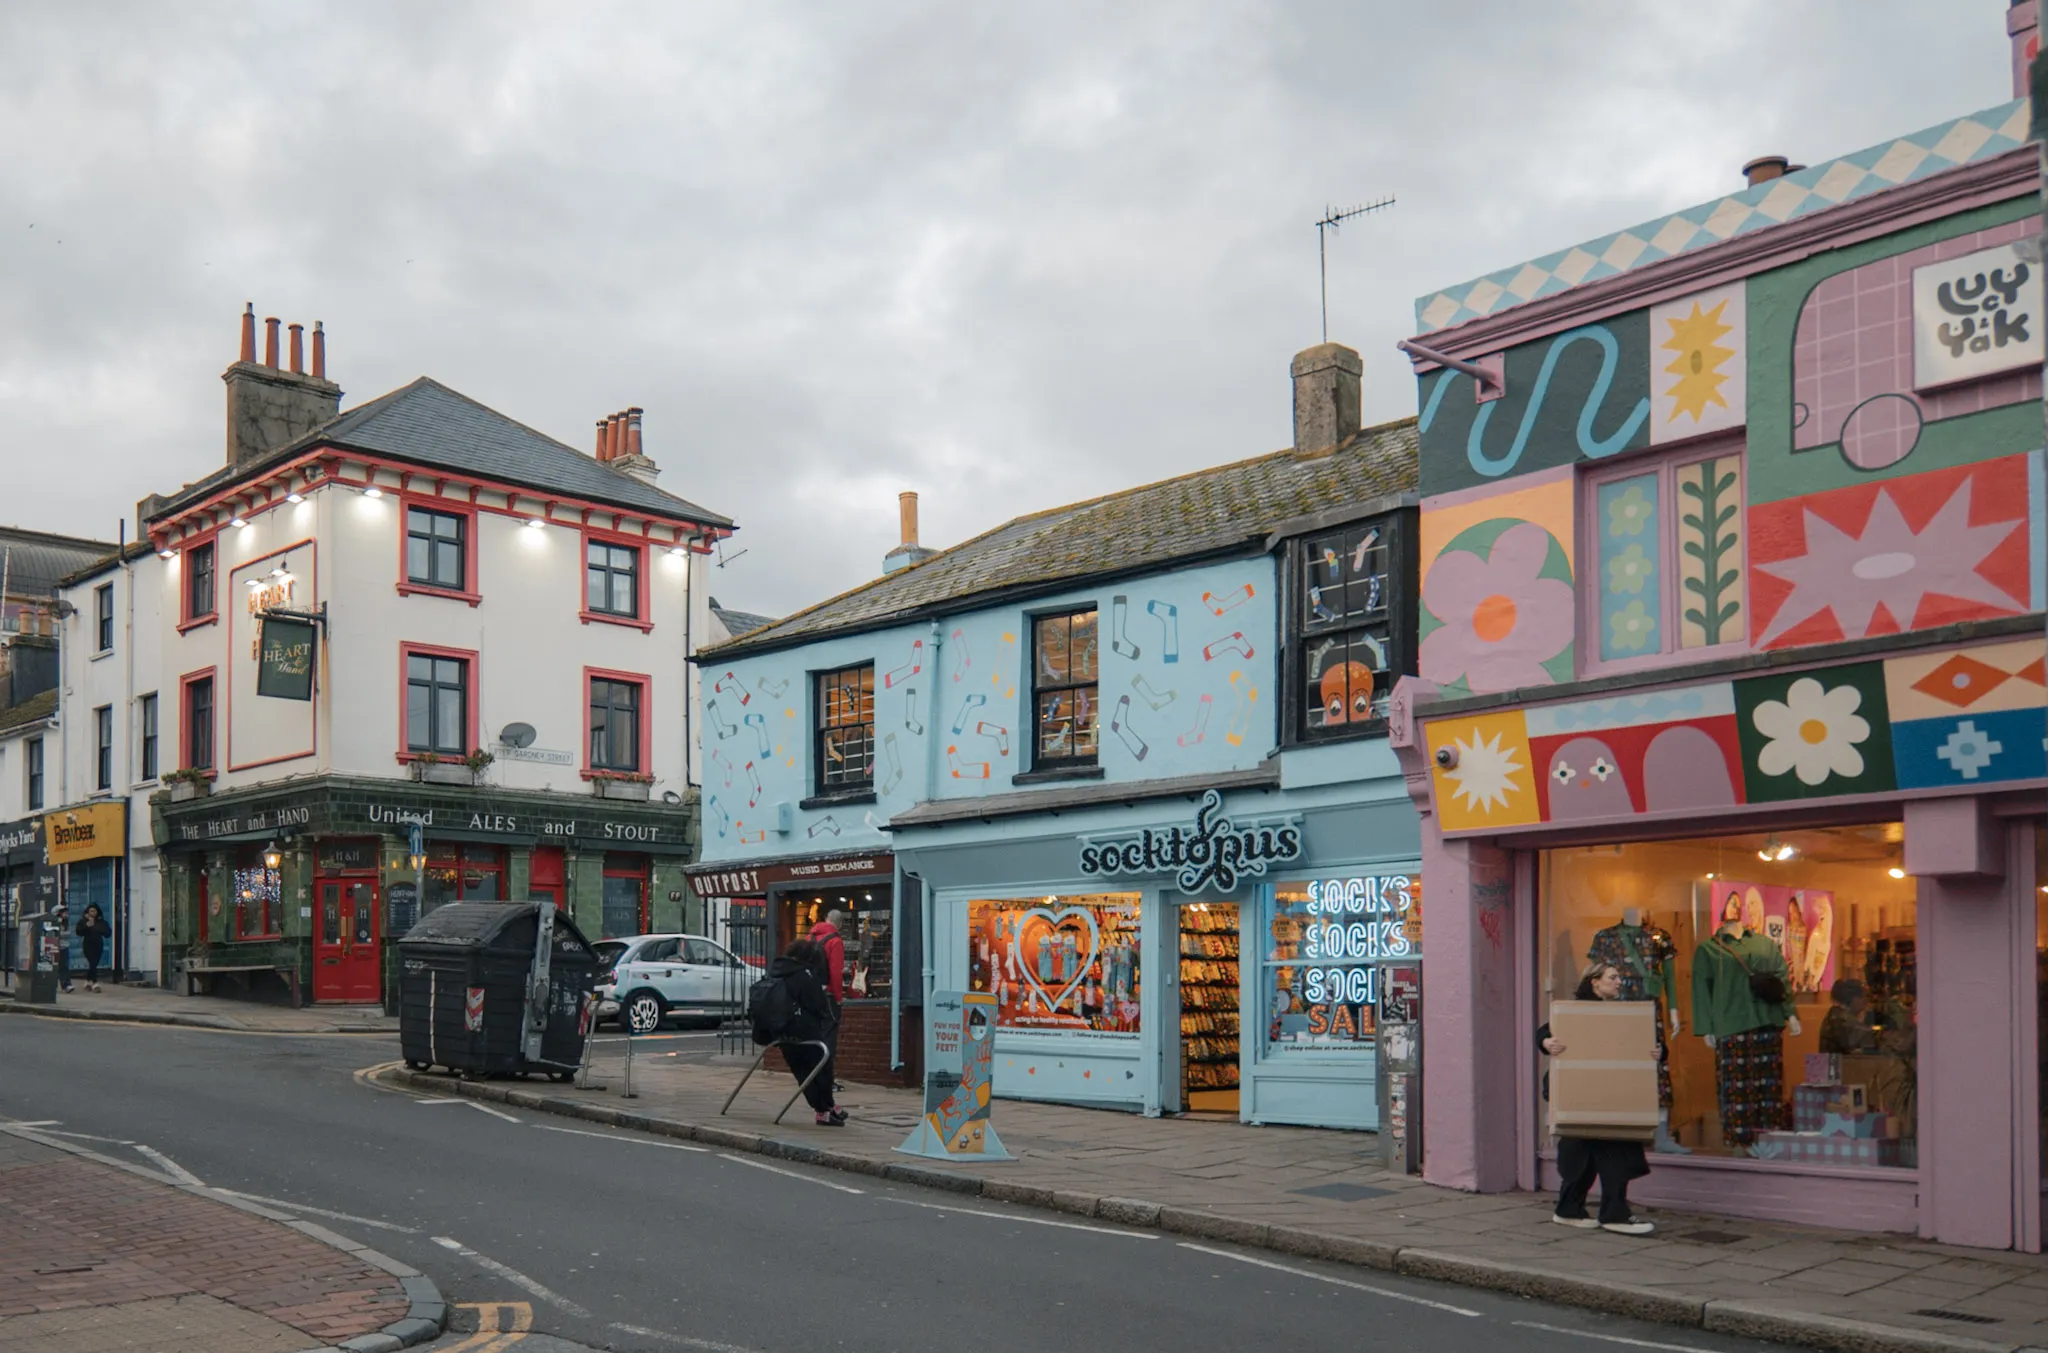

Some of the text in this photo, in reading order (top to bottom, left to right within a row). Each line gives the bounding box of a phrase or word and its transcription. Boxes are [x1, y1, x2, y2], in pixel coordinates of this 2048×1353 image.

[1938, 309, 2029, 358] Yak
[248, 579, 295, 613] HEART
[264, 643, 310, 663] HEART
[278, 662, 308, 675] Hand
[182, 807, 309, 839] THE HEART and HAND
[469, 813, 516, 831] ALES
[545, 821, 575, 836] and
[604, 823, 659, 841] STOUT
[1081, 790, 1300, 892] socktopus
[694, 871, 759, 894] OUTPOST
[790, 860, 875, 876] MUSIC EXCHANGE
[1306, 876, 1411, 915] SOCKS
[1305, 921, 1410, 958] SOCKS
[1305, 967, 1376, 1003] SOC
[936, 1032, 958, 1041] YOUR
